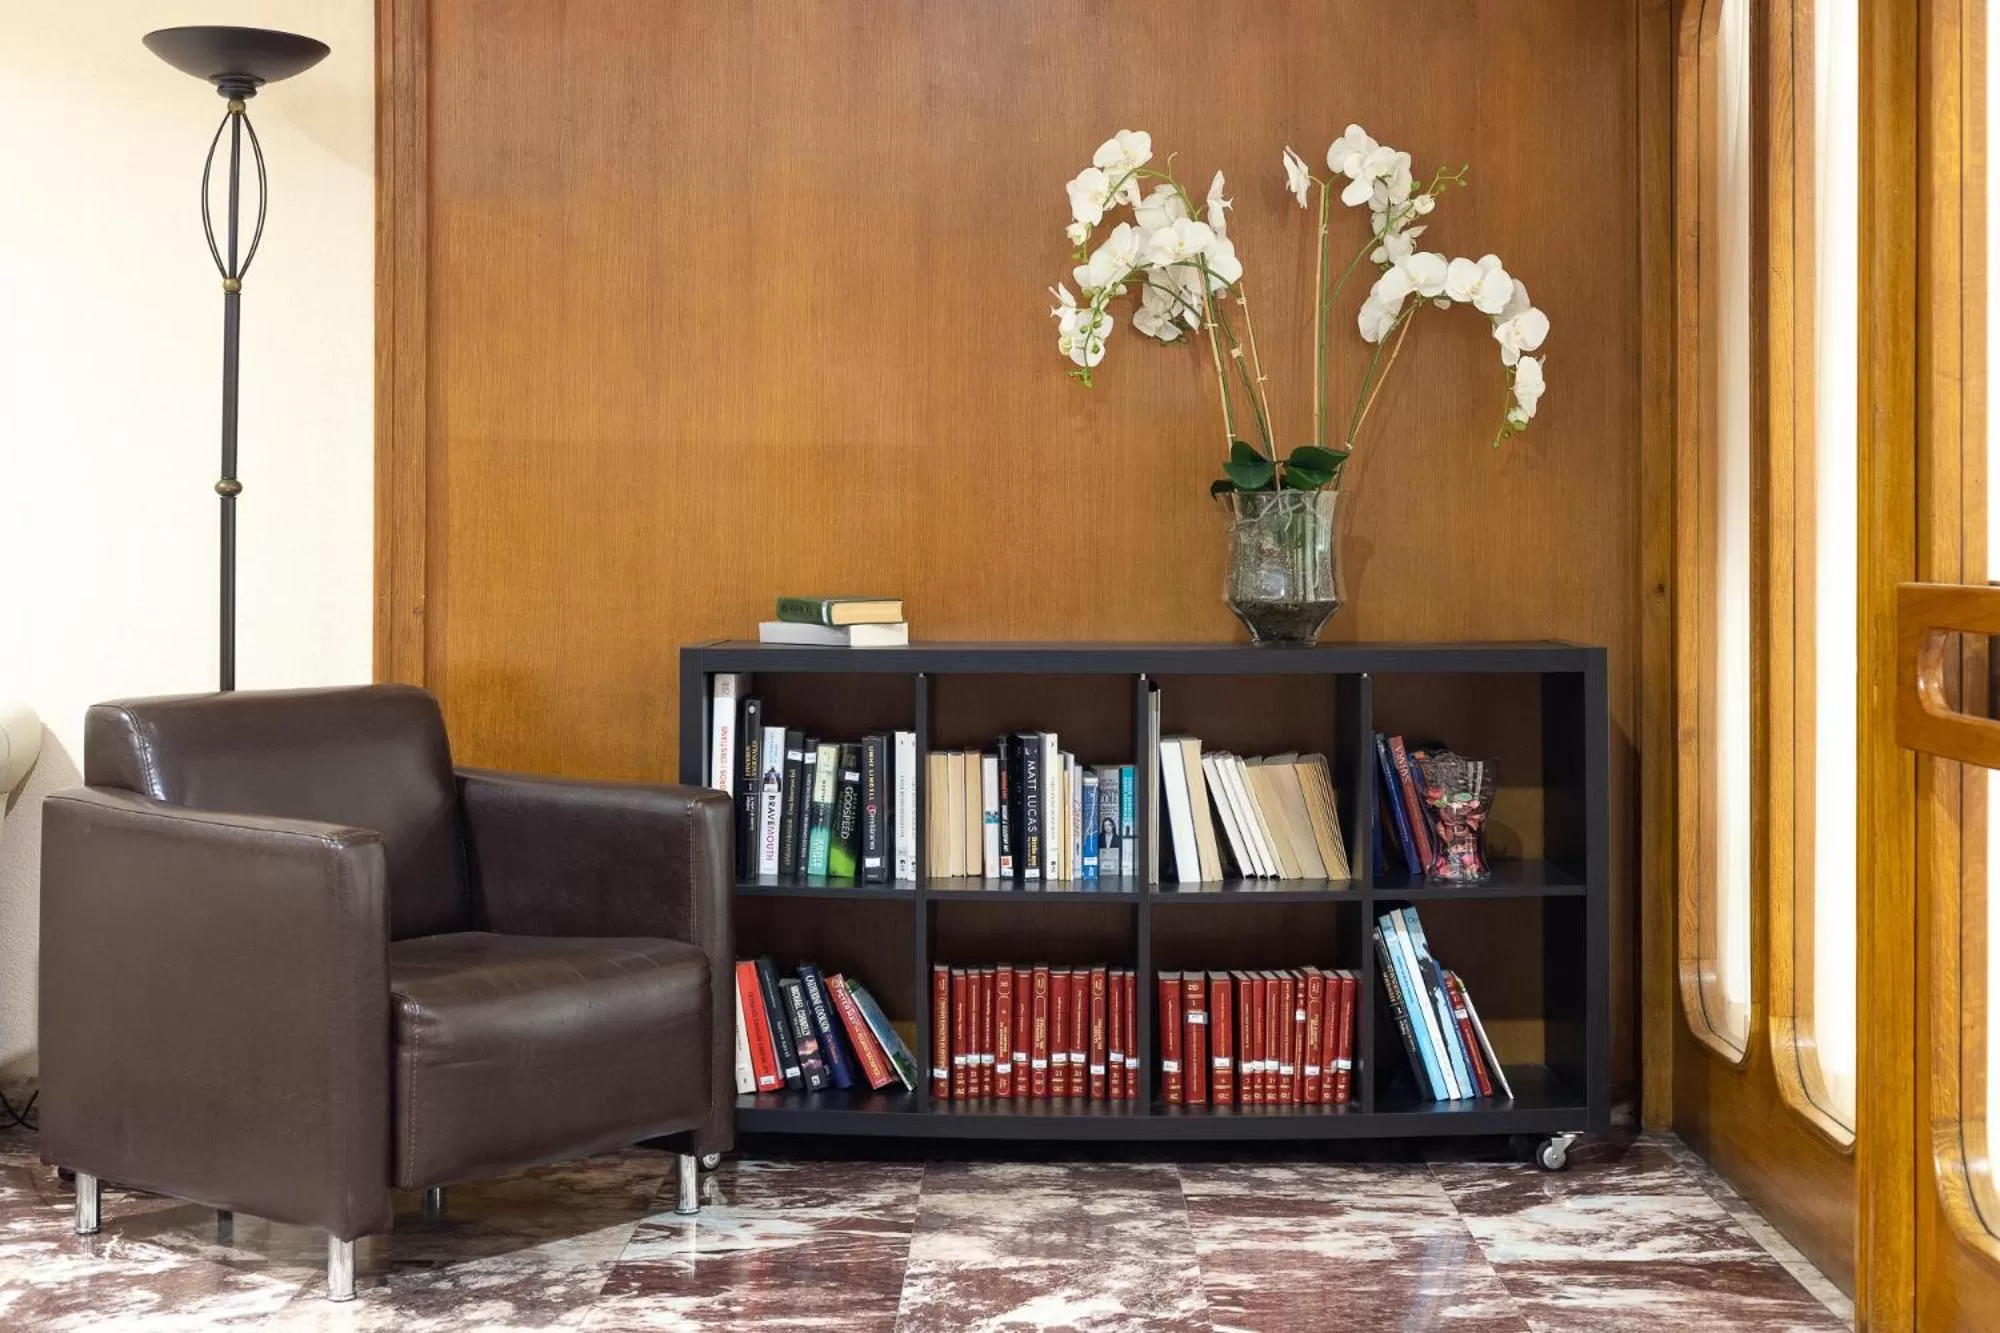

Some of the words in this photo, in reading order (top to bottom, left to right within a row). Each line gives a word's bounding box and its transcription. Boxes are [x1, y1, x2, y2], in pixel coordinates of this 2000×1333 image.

[1027, 760, 1037, 790] MATT
[766, 795, 776, 861] BRAVEMOUTH
[840, 786, 854, 840] GODSPEED
[1027, 795, 1037, 833] LUCAS
